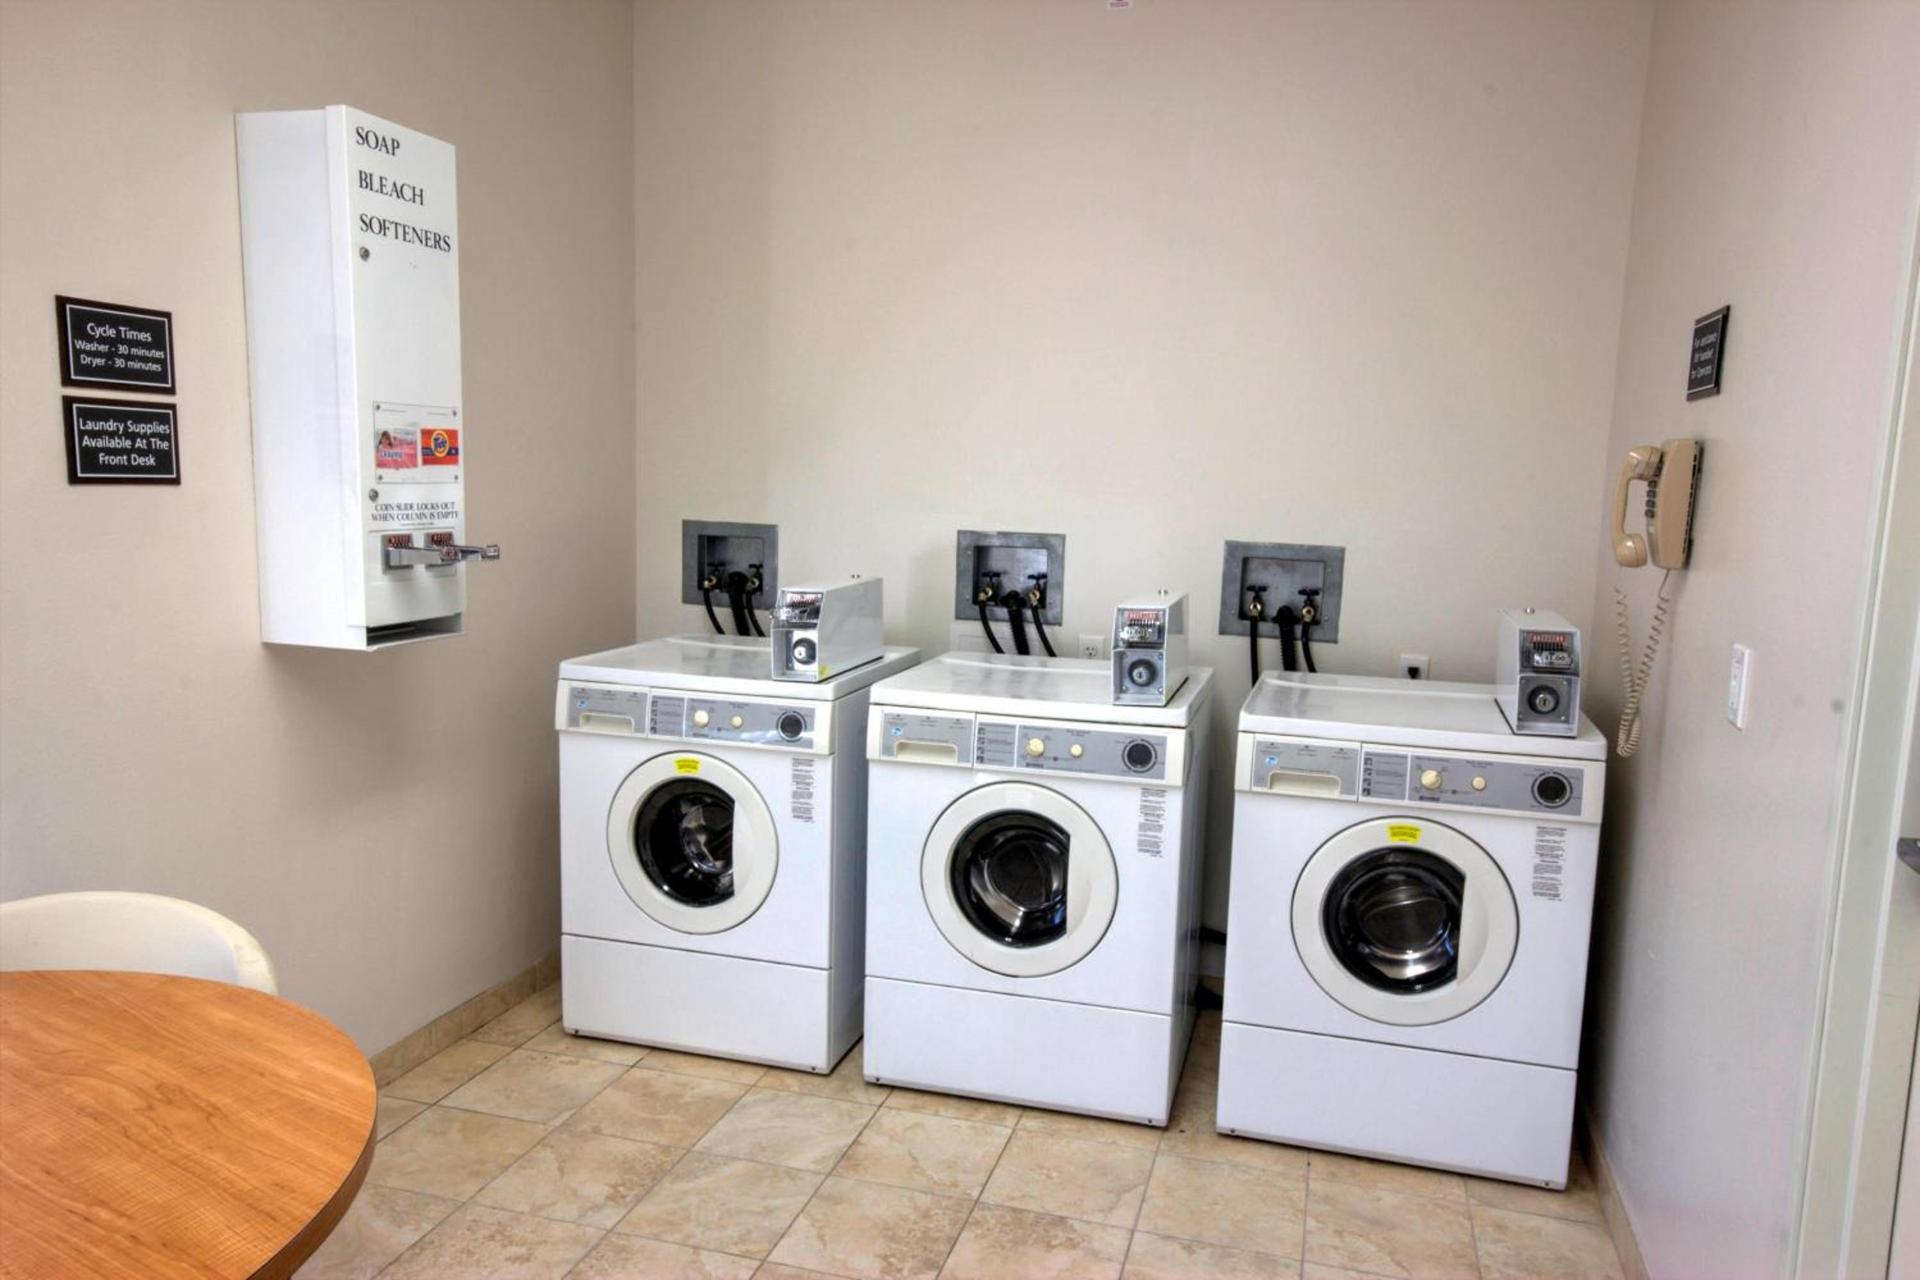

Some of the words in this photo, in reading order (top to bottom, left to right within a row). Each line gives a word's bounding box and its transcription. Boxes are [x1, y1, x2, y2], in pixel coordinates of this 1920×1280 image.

[355, 126, 400, 157] SOAP
[358, 169, 424, 206] BLEACH
[359, 212, 451, 253] SOFTENERS
[87, 322, 117, 338] Cycle
[118, 326, 152, 342] Times
[74, 339, 109, 353] Washer
[117, 344, 129, 354] 30
[130, 346, 165, 359] minutes
[80, 354, 106, 367] Dryer
[114, 358, 125, 368] 30
[127, 359, 162, 372] minutes
[79, 418, 124, 434] Laundry
[127, 420, 170, 436] Supplies
[82, 435, 132, 449] Available
[134, 438, 147, 449] At
[149, 438, 169, 450] The
[99, 452, 128, 465] Front
[131, 453, 156, 466] Desk
[374, 503, 394, 512] COIN
[416, 501, 439, 511] LOCKS
[440, 501, 456, 510] OUT
[371, 512, 395, 522] WHEN
[429, 511, 436, 520] IS
[437, 510, 458, 521] EMPTY
